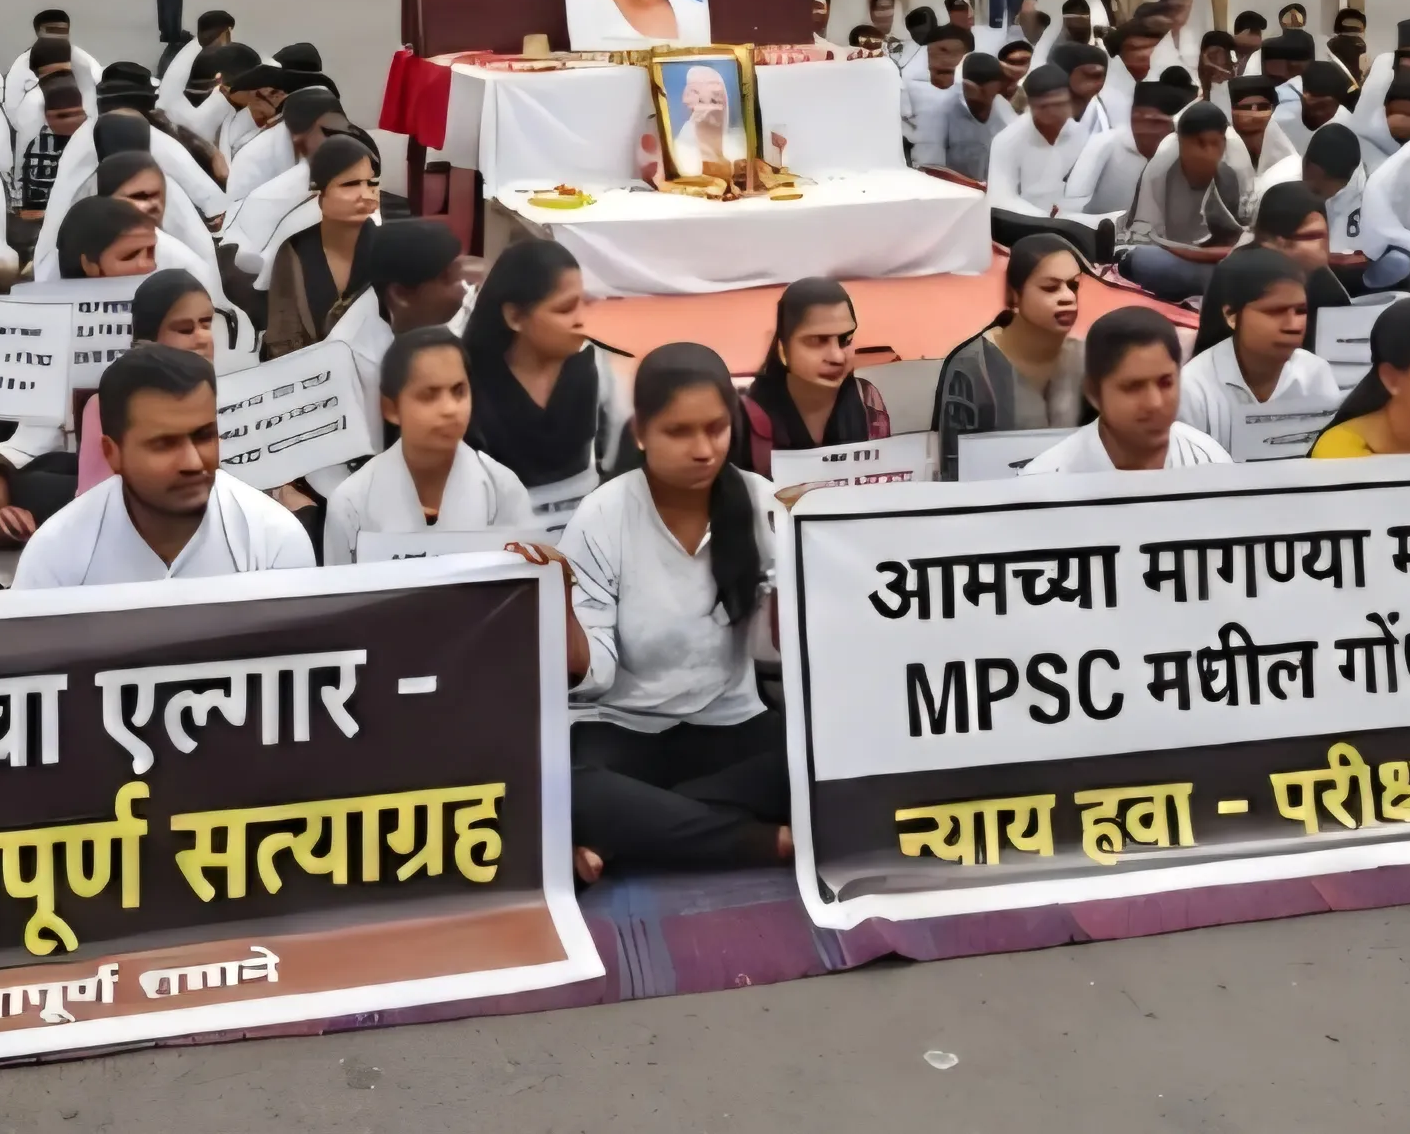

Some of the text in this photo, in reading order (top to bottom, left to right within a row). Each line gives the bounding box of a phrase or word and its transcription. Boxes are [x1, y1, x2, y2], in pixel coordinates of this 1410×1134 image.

[867, 545, 1121, 620] आमच्या
[1139, 529, 1372, 603] मागण्या
[94, 649, 367, 775] एल्गार
[906, 649, 1125, 738] MPSC
[171, 783, 505, 901] सत्याग्रह
[895, 794, 1056, 864] न्याय
